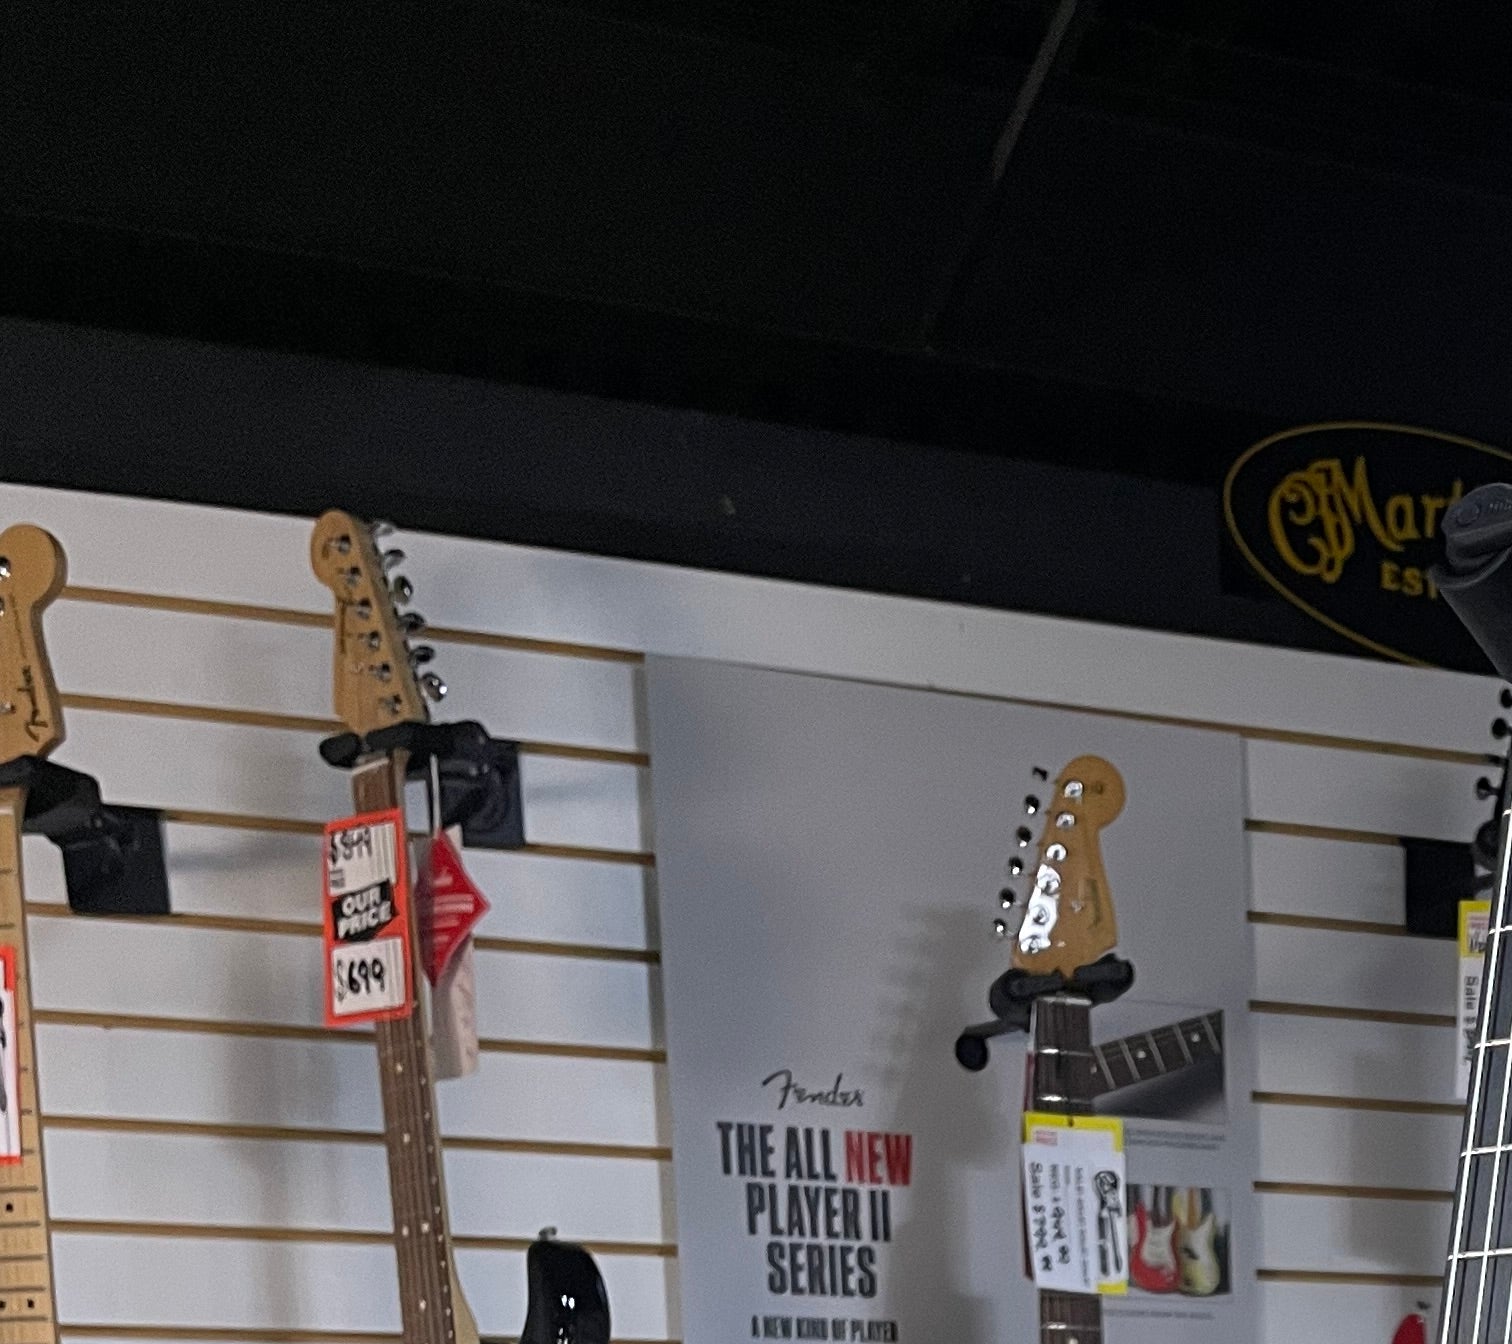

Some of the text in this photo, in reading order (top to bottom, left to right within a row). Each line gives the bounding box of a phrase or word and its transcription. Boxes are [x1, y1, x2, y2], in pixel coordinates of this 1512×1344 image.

[337, 901, 392, 940] PRICE
[342, 885, 382, 916] OUR
[336, 957, 386, 1003] $699
[762, 1069, 864, 1109] Fender
[716, 1121, 913, 1186] THE ALL NEW
[746, 1183, 893, 1243] PLAYER II
[767, 1241, 877, 1298] SERIES
[751, 1316, 760, 1339] A
[763, 1316, 792, 1340] NEW
[851, 1319, 898, 1344] PLAYER
